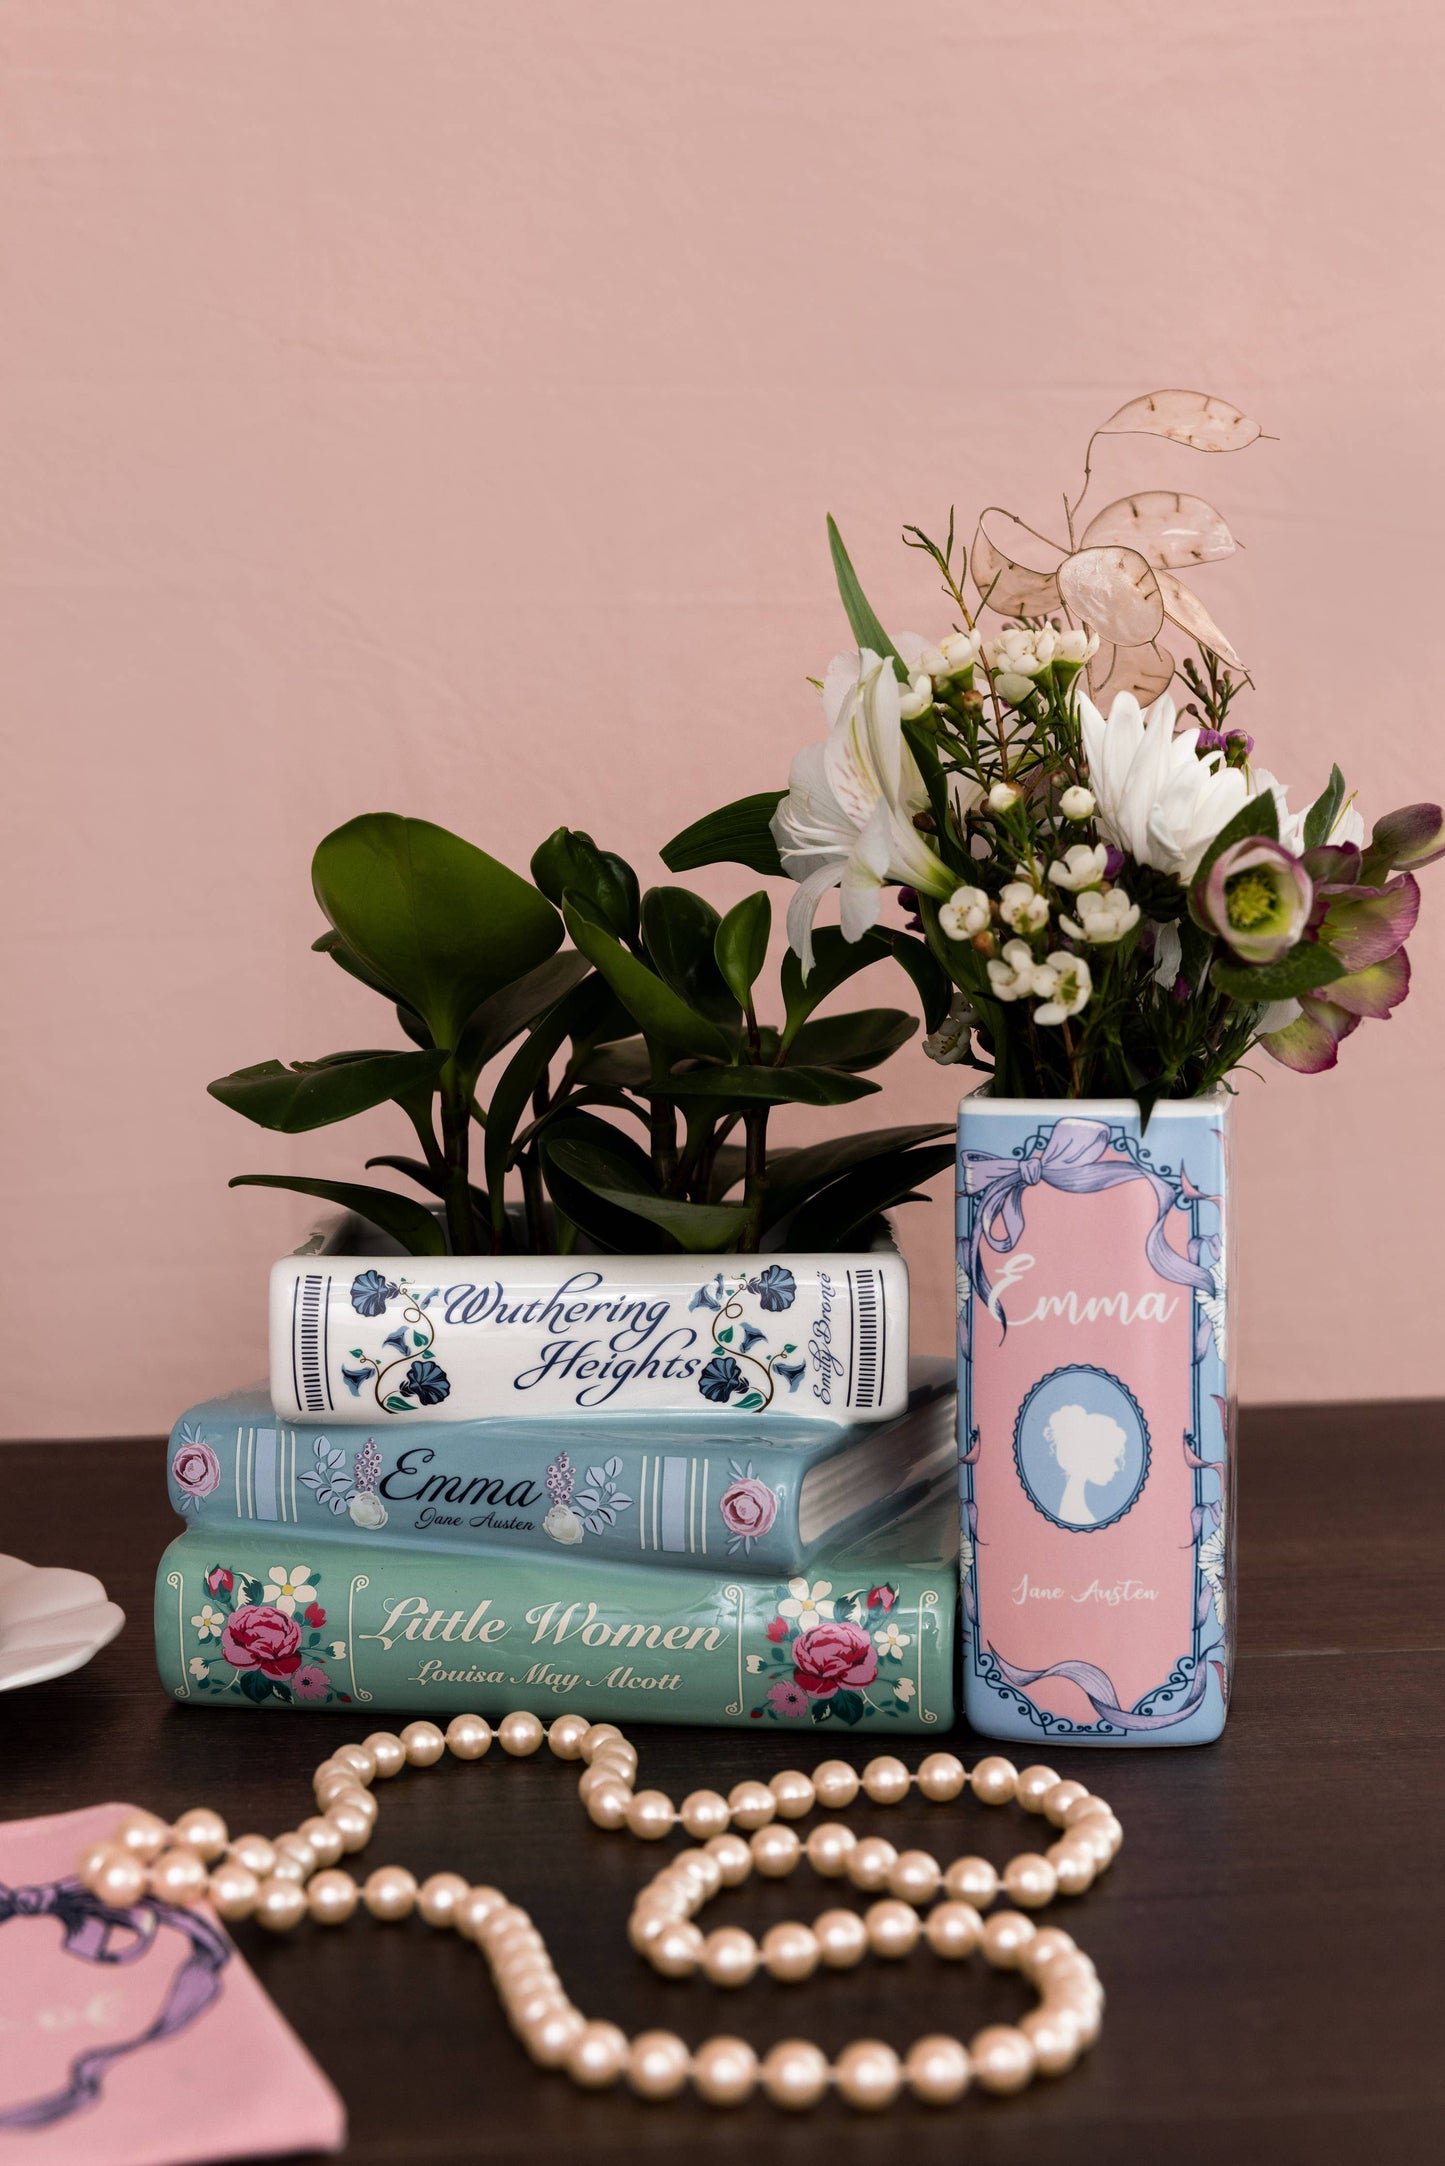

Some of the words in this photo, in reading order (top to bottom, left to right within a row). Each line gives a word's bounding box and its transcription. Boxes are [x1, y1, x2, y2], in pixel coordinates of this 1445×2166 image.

[443, 1271, 671, 1353] Wuthering
[812, 1271, 837, 1345] Brontë
[987, 1253, 1180, 1327] Emma
[513, 1327, 702, 1407] Heights
[807, 1339, 845, 1405] Emily
[378, 1448, 543, 1508] Emma
[414, 1507, 464, 1530] Jane
[468, 1511, 536, 1531] Austen
[1011, 1573, 1065, 1605] Jane
[1070, 1579, 1160, 1606] Austen
[358, 1596, 513, 1651] Little
[524, 1600, 731, 1651] Women
[407, 1658, 508, 1687] Louisa
[509, 1662, 584, 1694] May
[585, 1665, 688, 1691] Alcott
